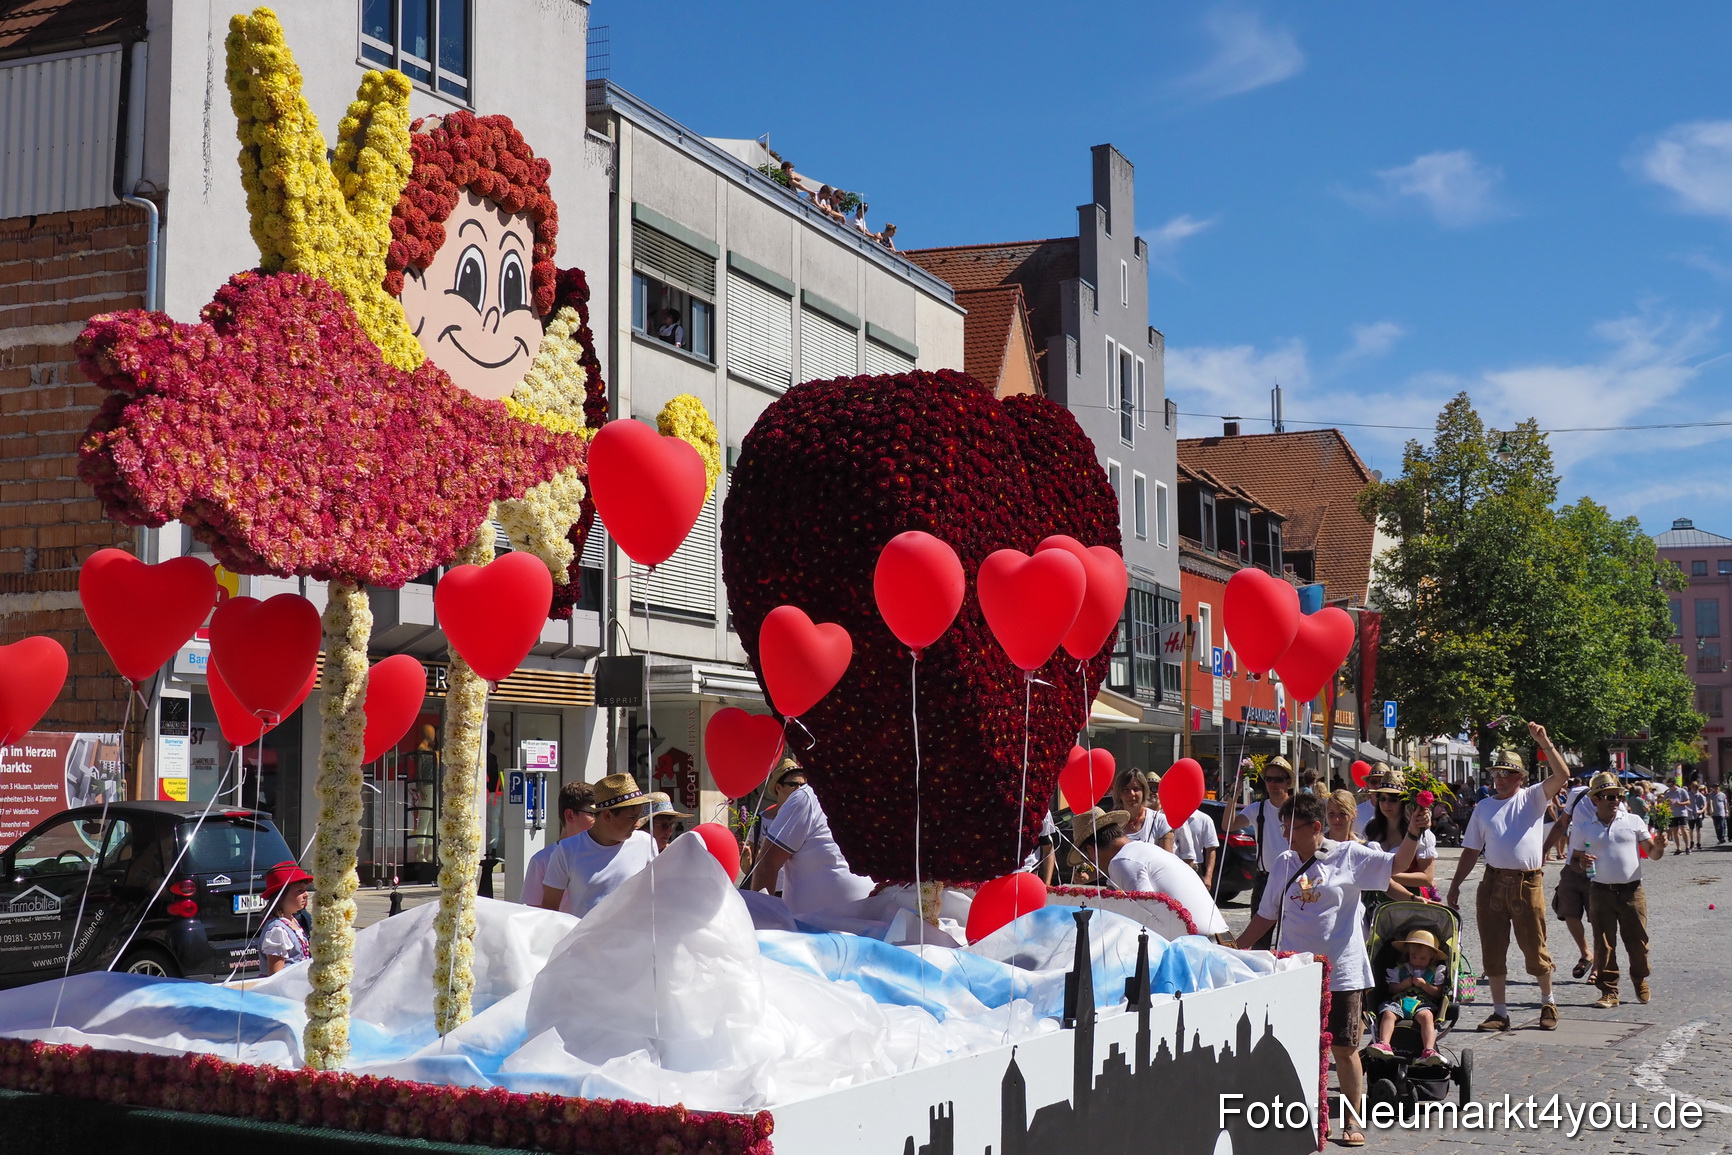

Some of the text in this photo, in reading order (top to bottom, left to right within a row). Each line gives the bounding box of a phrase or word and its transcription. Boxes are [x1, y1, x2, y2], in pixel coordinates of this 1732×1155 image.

[1164, 631, 1196, 654] H&M
[1214, 651, 1221, 673] P
[603, 697, 638, 705] ESPRIT
[1387, 704, 1394, 725] P
[190, 727, 205, 745] 37
[10, 745, 23, 757] im
[25, 745, 57, 758] Herzen
[3, 933, 23, 943] 09181
[28, 932, 42, 942] 520
[42, 932, 52, 941] 55
[52, 931, 61, 940] 77
